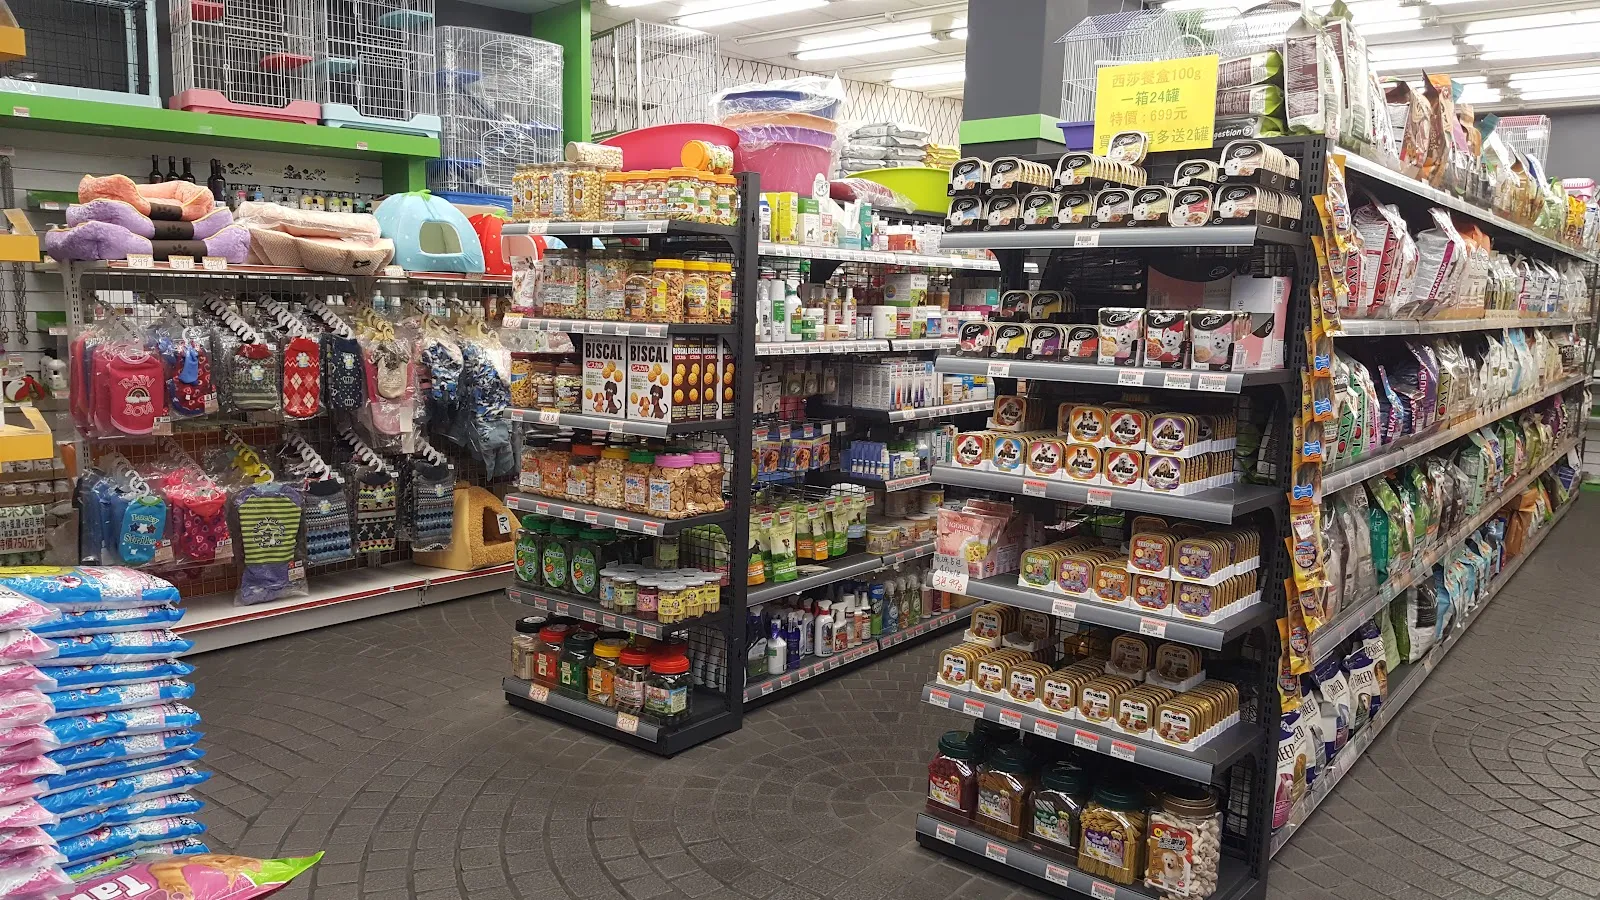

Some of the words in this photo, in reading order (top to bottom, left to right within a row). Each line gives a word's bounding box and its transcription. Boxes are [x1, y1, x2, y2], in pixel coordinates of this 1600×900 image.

[1112, 67, 1202, 89] 西莎餐盒100g
[1121, 87, 1180, 106] 一箱24罐
[133, 258, 149, 267] 299
[585, 342, 624, 361] BISCAL
[630, 345, 669, 363] BISCAL
[1077, 421, 1098, 432] Arias
[1114, 425, 1136, 436] Arias
[1156, 429, 1180, 441] Arias
[960, 446, 978, 456] Arias
[998, 449, 1016, 459] Arias
[1035, 453, 1055, 464] Arias
[1071, 458, 1092, 469] Arias
[1112, 464, 1134, 475] Arias
[1152, 468, 1175, 479] Arias
